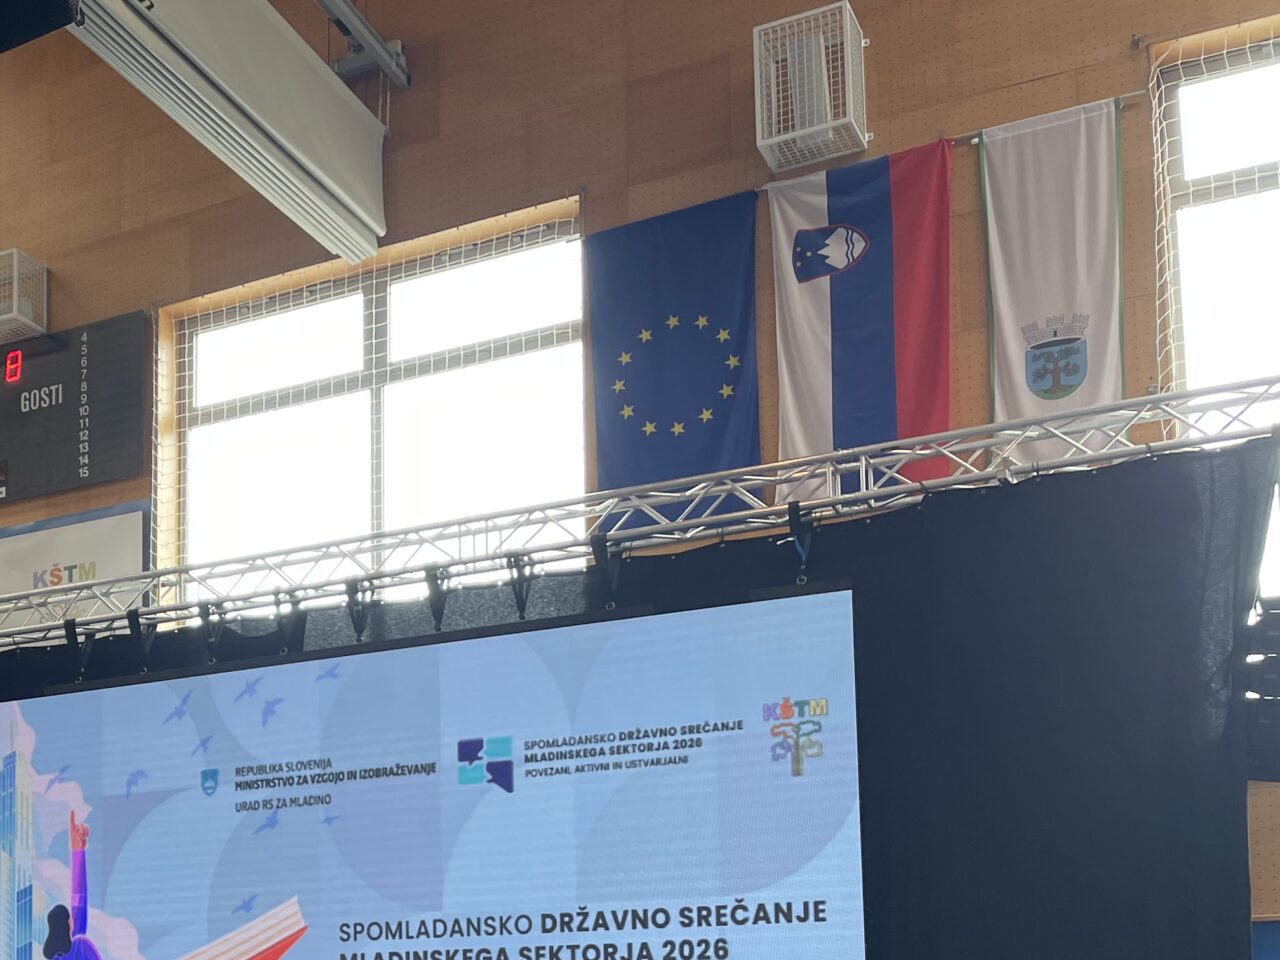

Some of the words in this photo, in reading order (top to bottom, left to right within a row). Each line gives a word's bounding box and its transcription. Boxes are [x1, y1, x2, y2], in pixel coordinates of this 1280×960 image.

[80, 331, 88, 342] 4
[80, 344, 88, 355] 5
[5, 350, 22, 382] 8
[80, 356, 88, 367] 6
[80, 368, 88, 379] 7
[80, 381, 88, 392] 8
[20, 383, 63, 413] GOSTI
[80, 393, 88, 404] 9
[78, 405, 90, 416] 10
[79, 417, 90, 428] 11
[78, 430, 90, 441] 12
[78, 442, 90, 453] 13
[78, 454, 90, 466] 14
[78, 467, 90, 478] 15
[32, 561, 96, 589] KŠTM
[762, 697, 828, 721] KŠTM
[524, 732, 616, 750] SPOMLADANSKO
[618, 726, 677, 742] DRŽAVNO
[680, 720, 744, 736] SREČANJE
[524, 747, 607, 764] MLADINSKEGA
[608, 741, 670, 756] SEKTORJA
[672, 737, 703, 750] 2026
[235, 763, 284, 777] REPUBLIKA
[285, 758, 333, 773] SLOVENIJA
[574, 761, 610, 773] AKTIVNI
[612, 761, 623, 770] IN
[624, 755, 689, 769] USTVARJALNI
[235, 776, 295, 791] MINISTRSTVO
[296, 774, 310, 786] ZA
[310, 771, 345, 785] VZGOJO
[346, 770, 358, 781] IN
[359, 762, 437, 780] IZOBRAŽEVANJE
[235, 800, 261, 813] URAD
[262, 798, 274, 810] RS
[275, 797, 288, 809] ZA
[289, 794, 332, 808] MLADINO
[339, 914, 533, 943] SPOMLADANSKO
[540, 905, 671, 934] DRŽAVNO
[678, 897, 828, 928] SREČANJE
